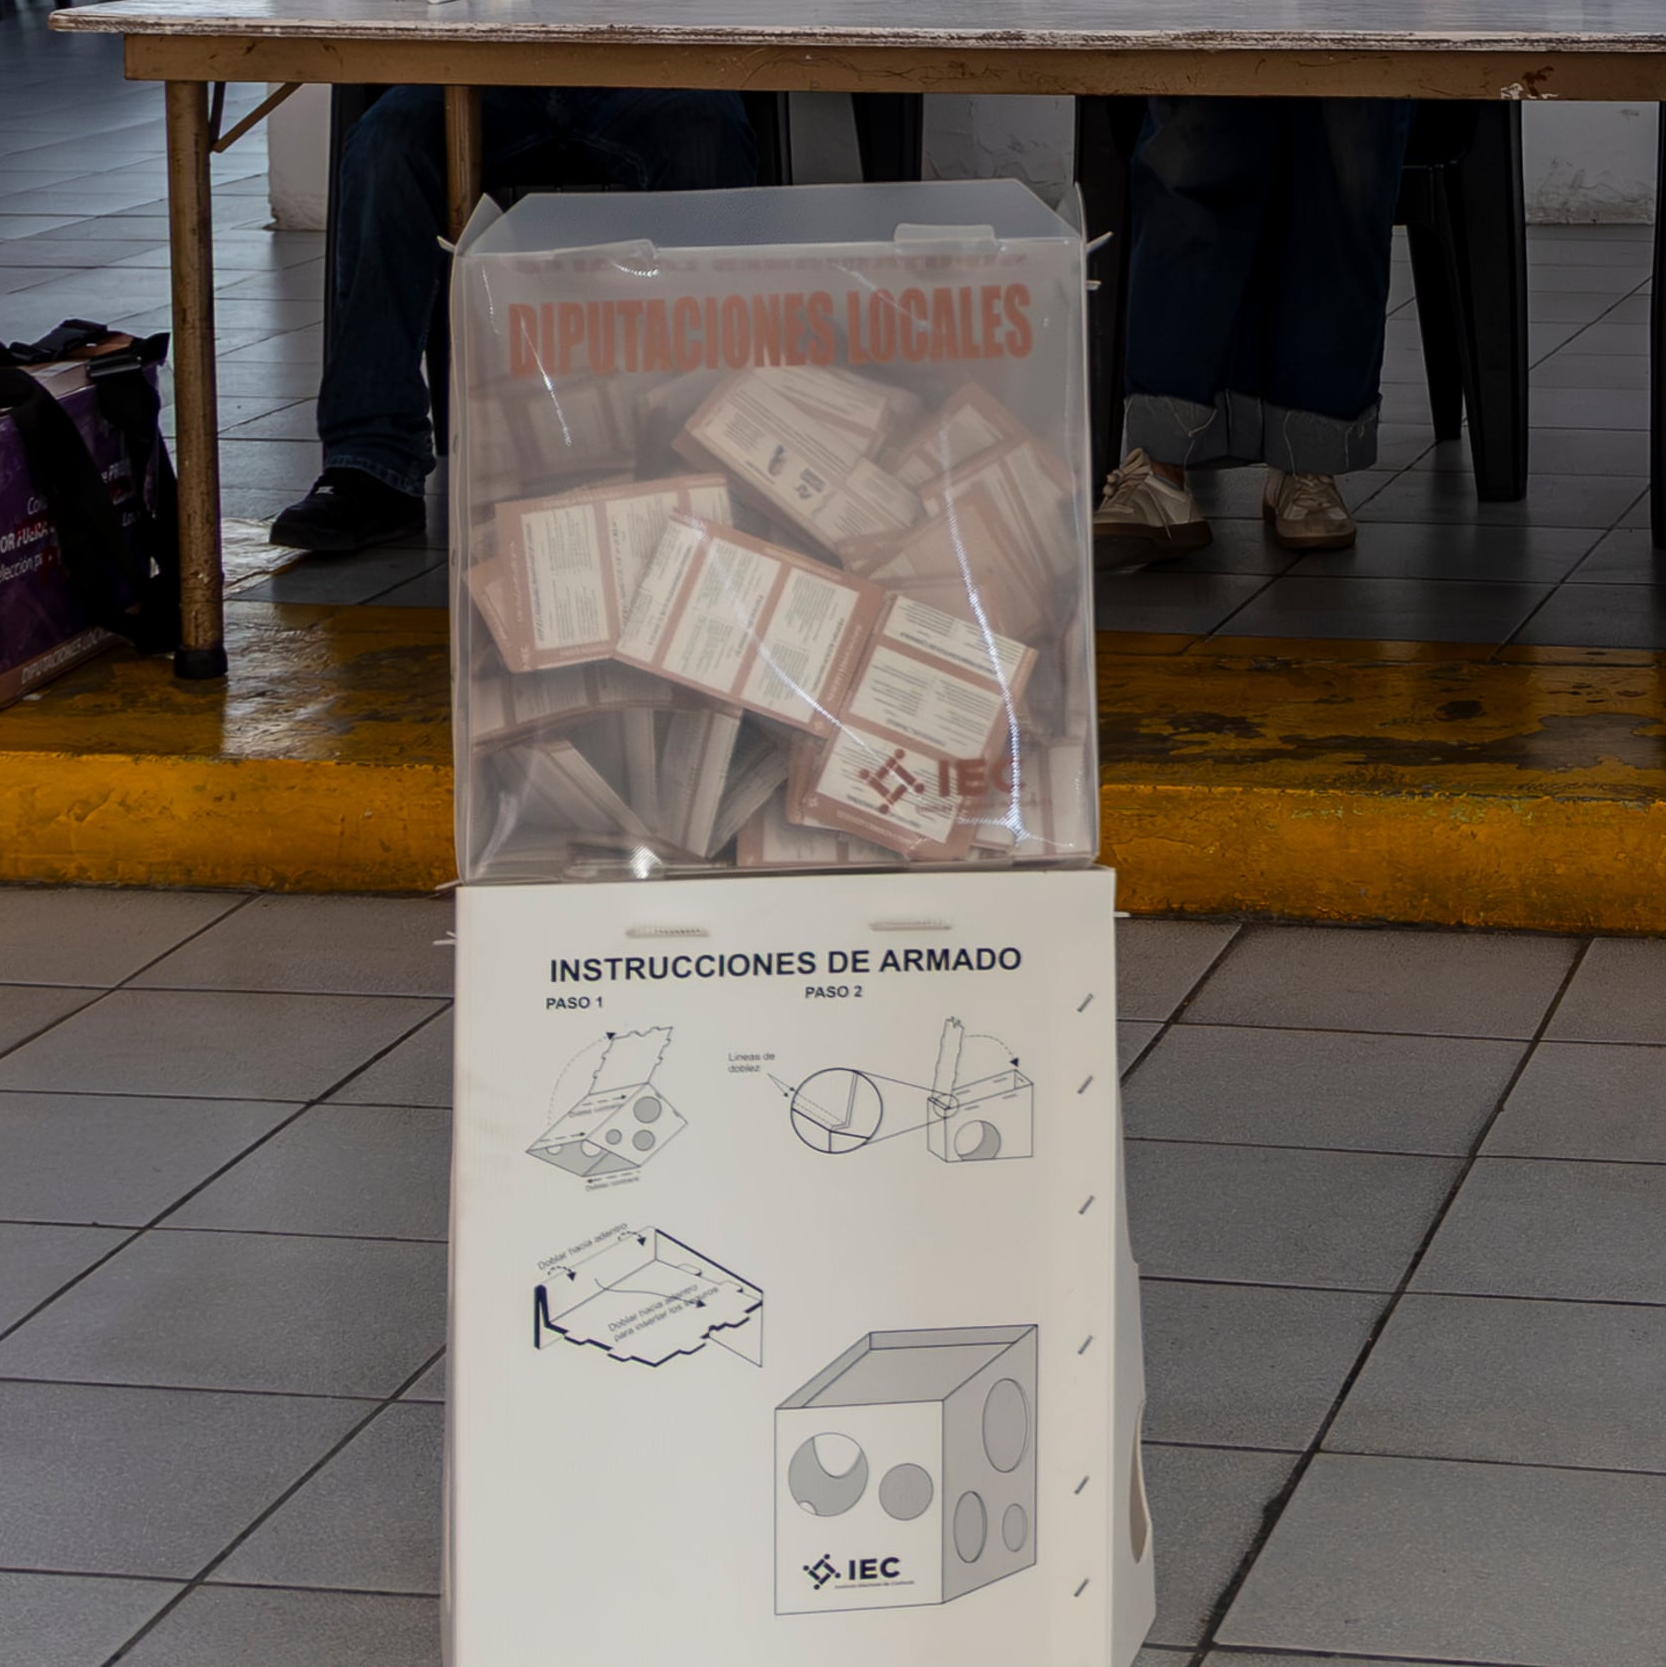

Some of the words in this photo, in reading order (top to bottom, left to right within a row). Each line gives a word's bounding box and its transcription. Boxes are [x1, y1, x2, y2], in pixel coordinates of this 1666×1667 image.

[507, 292, 835, 379] DIPUTACIONES
[846, 282, 1033, 366] LOCALES
[937, 756, 1026, 799] IEC
[549, 951, 817, 983] INSTRUCCIONES
[827, 949, 869, 975] DE
[879, 945, 1022, 974] ARMADO
[546, 995, 590, 1010] PASO
[596, 995, 604, 1008] 1
[804, 985, 849, 1000] PASO
[853, 985, 863, 998] 2
[763, 1052, 776, 1060] de
[537, 1250, 569, 1272] Doblar
[568, 1238, 594, 1258] hacia
[594, 1222, 629, 1245] adentro
[608, 1311, 638, 1333] Doblar
[638, 1300, 664, 1320] hacia
[613, 1327, 636, 1343] para
[668, 1303, 683, 1317] los
[849, 1556, 900, 1580] IEC
